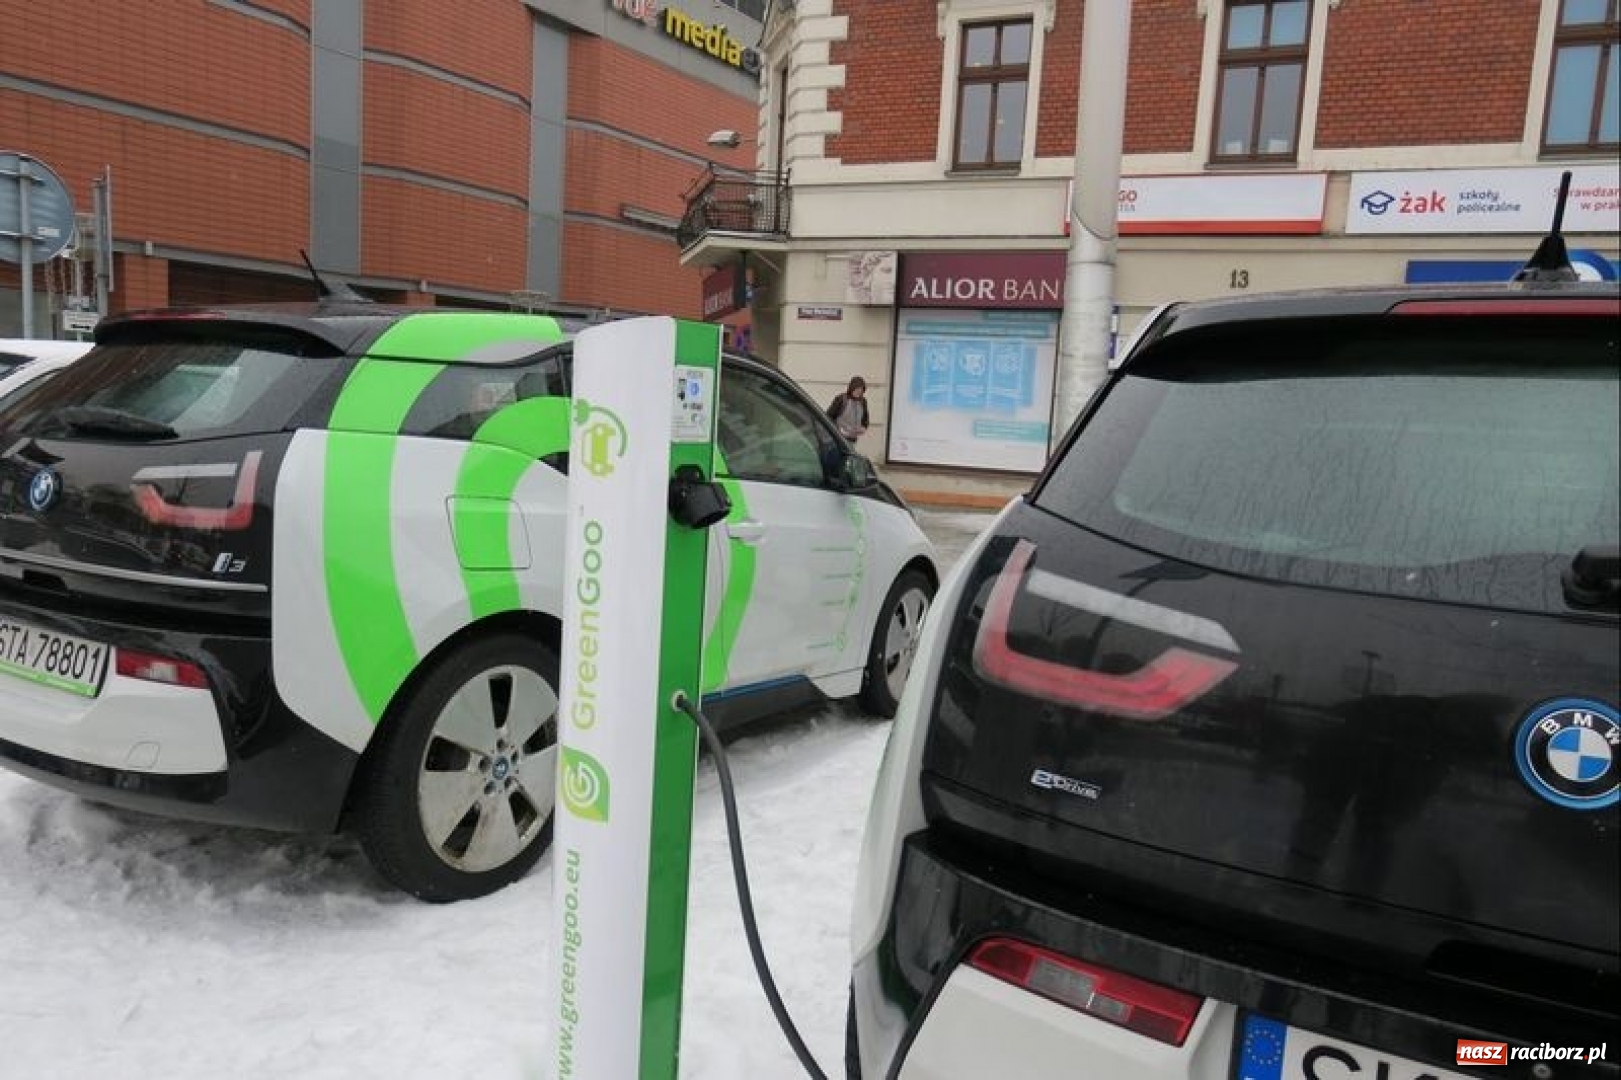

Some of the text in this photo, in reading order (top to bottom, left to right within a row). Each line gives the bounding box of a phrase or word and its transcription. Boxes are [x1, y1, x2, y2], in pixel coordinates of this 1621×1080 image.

[1399, 191, 1446, 214] żak
[1459, 189, 1499, 201] szkoły
[1457, 202, 1521, 215] policealne
[911, 276, 1060, 302] ALIOR BAN
[1229, 269, 1249, 289] 13
[571, 519, 603, 731] GreenGoo
[31, 632, 101, 684] 78801
[557, 848, 582, 1080] ww.greengoo.eu
